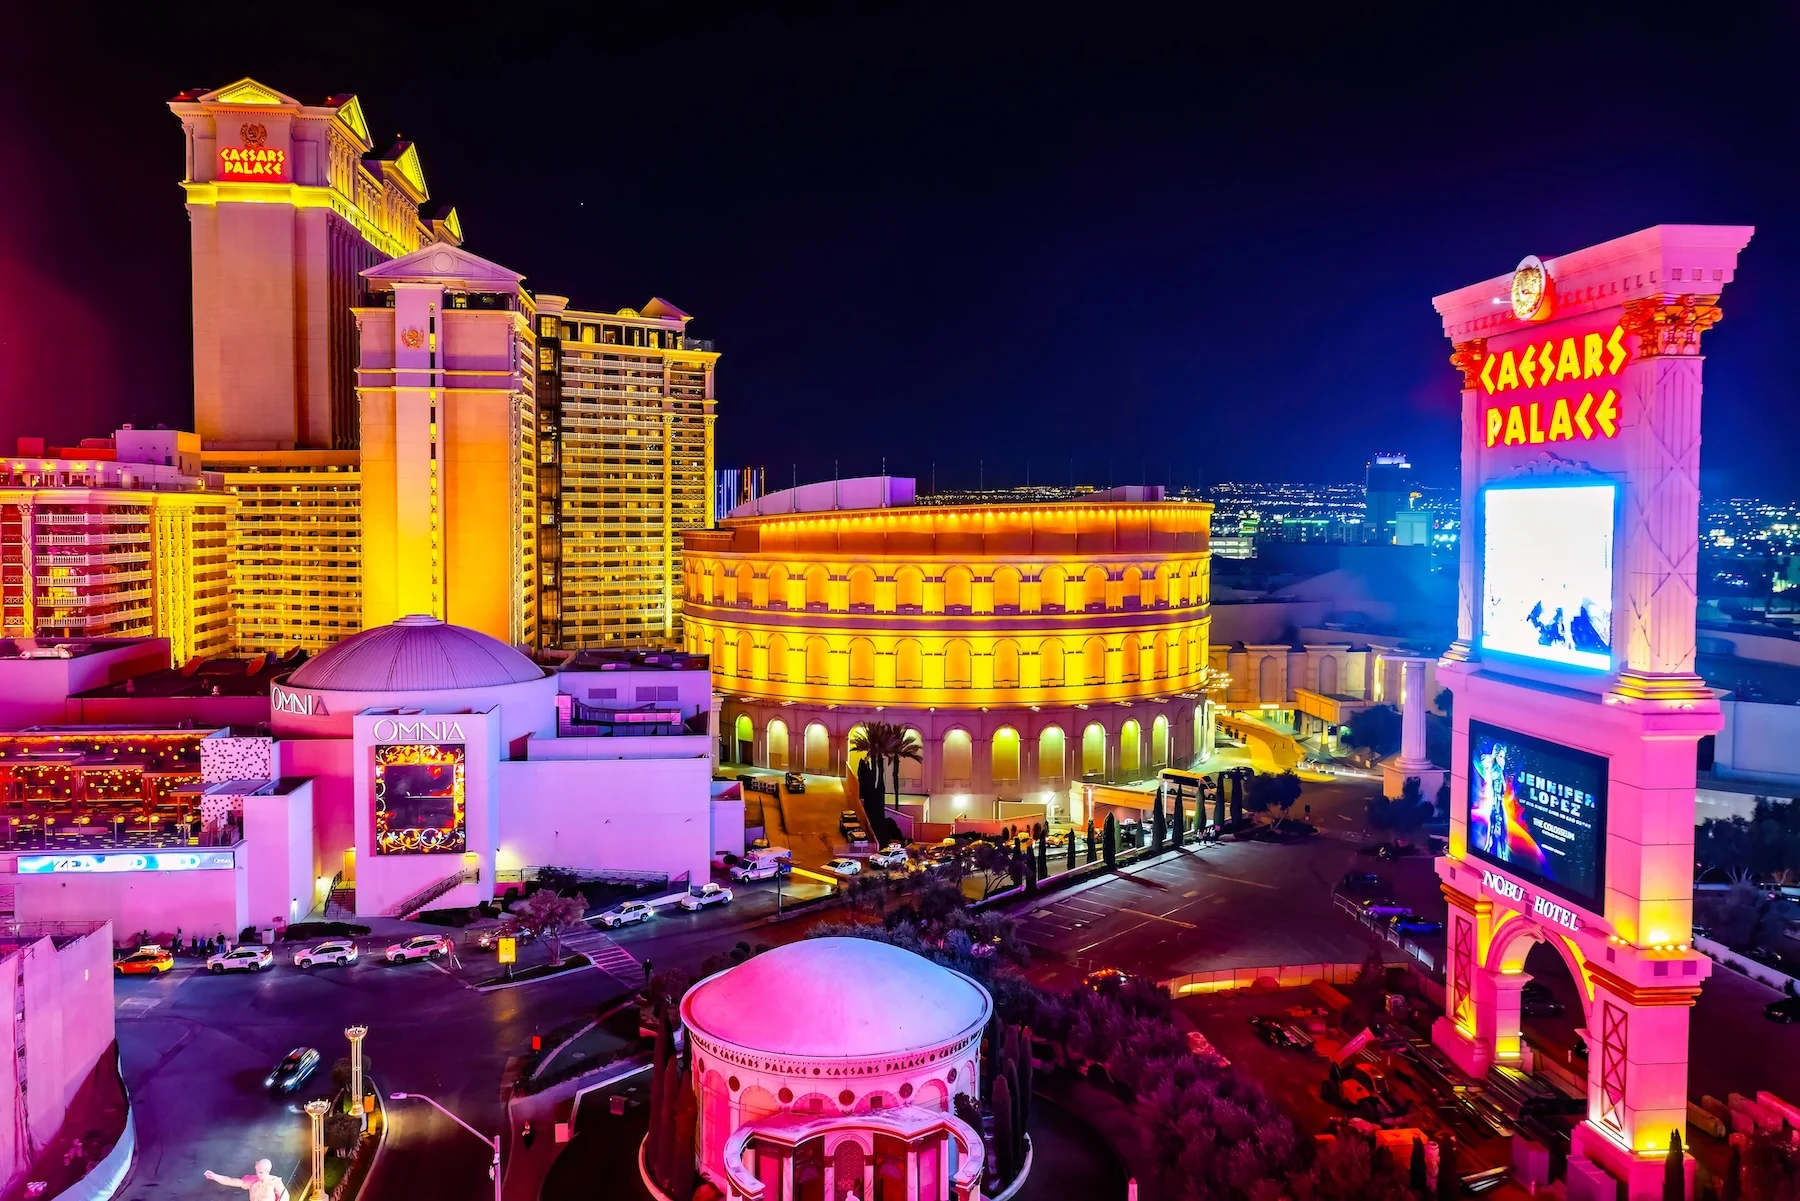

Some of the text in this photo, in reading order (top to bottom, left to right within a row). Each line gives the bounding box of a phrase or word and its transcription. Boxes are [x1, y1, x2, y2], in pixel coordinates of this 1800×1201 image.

[220, 148, 286, 163] CAESARS
[224, 161, 282, 175] PALACE
[1480, 325, 1627, 395] CAESARS
[1486, 389, 1617, 448] PALACE
[272, 686, 330, 716] OMNIA
[373, 718, 466, 742] OMNIA
[1517, 771, 1595, 809] JENNIFER
[1529, 787, 1581, 817] LOPEZ
[1482, 869, 1580, 932] NOBU HOTEL
[720, 1049, 759, 1068] CAESARS
[765, 1062, 807, 1075] PALACE
[826, 1065, 880, 1076] CAESARS
[886, 1056, 926, 1072] PALACE
